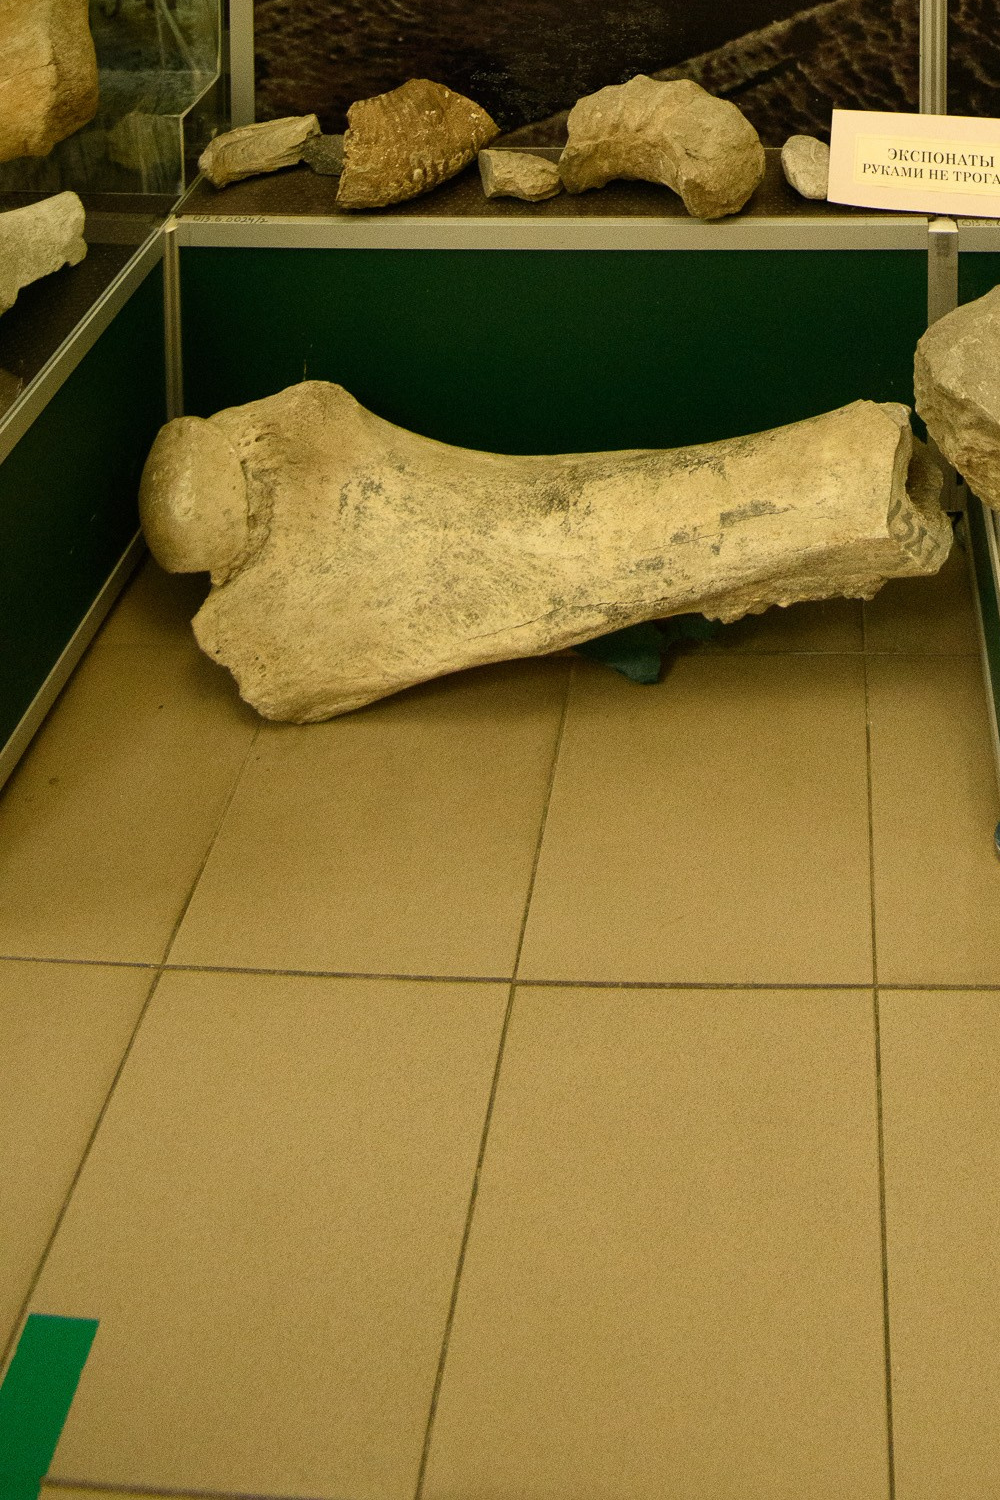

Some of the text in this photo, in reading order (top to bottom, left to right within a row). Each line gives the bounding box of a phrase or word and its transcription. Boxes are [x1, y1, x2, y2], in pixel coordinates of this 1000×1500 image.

[888, 148, 995, 168] ЭКСПОНАТЫ
[862, 163, 923, 178] РУКАМИ
[929, 169, 948, 180] НЕ
